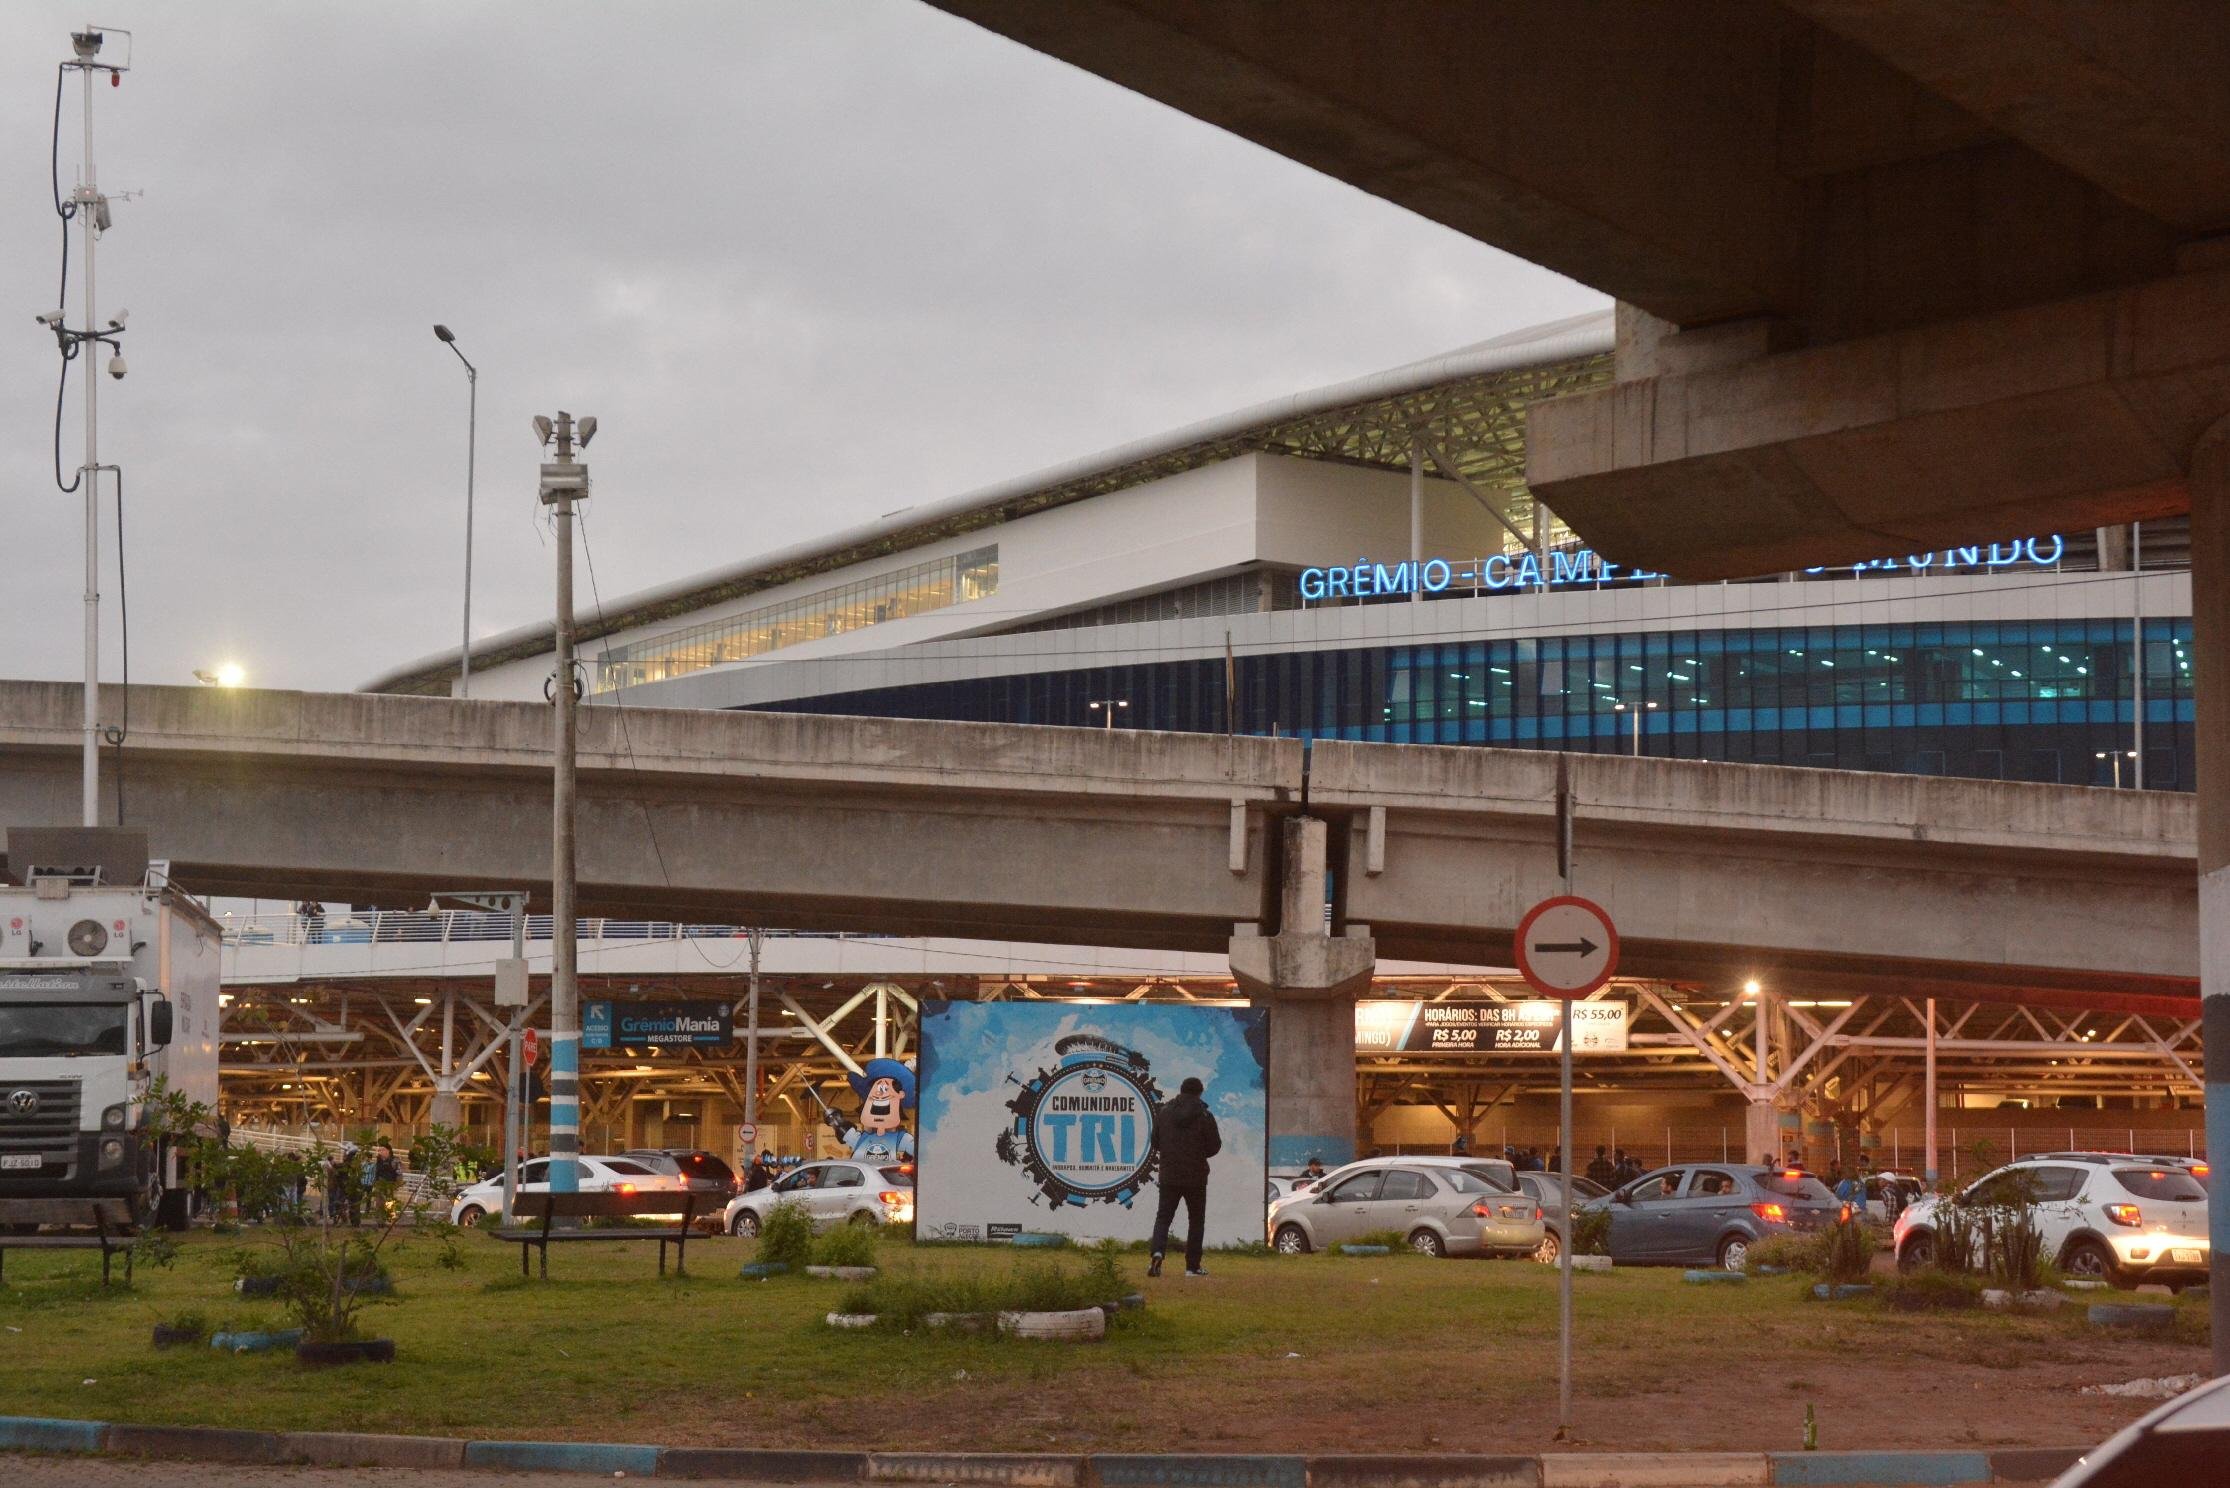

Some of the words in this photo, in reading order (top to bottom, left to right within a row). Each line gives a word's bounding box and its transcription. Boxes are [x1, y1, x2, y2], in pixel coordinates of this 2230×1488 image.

[1300, 556, 1451, 600] GRÊMIO
[1424, 1006, 1478, 1022] HORÁRIOS:
[1480, 1008, 1500, 1022] DAS
[1501, 1008, 1516, 1021] 8H
[1572, 1008, 1588, 1020] R$
[621, 1016, 720, 1032] GrêmioMania
[647, 1034, 692, 1043] MEGASTORE
[1433, 1028, 1449, 1041] R$
[1450, 1029, 1477, 1041] 5,00
[1496, 1028, 1513, 1041] R$
[1514, 1029, 1540, 1041] 2,00
[524, 1041, 537, 1052] PARE
[1052, 1096, 1135, 1112] COMUNIDADE
[1043, 1113, 1136, 1163] TRI
